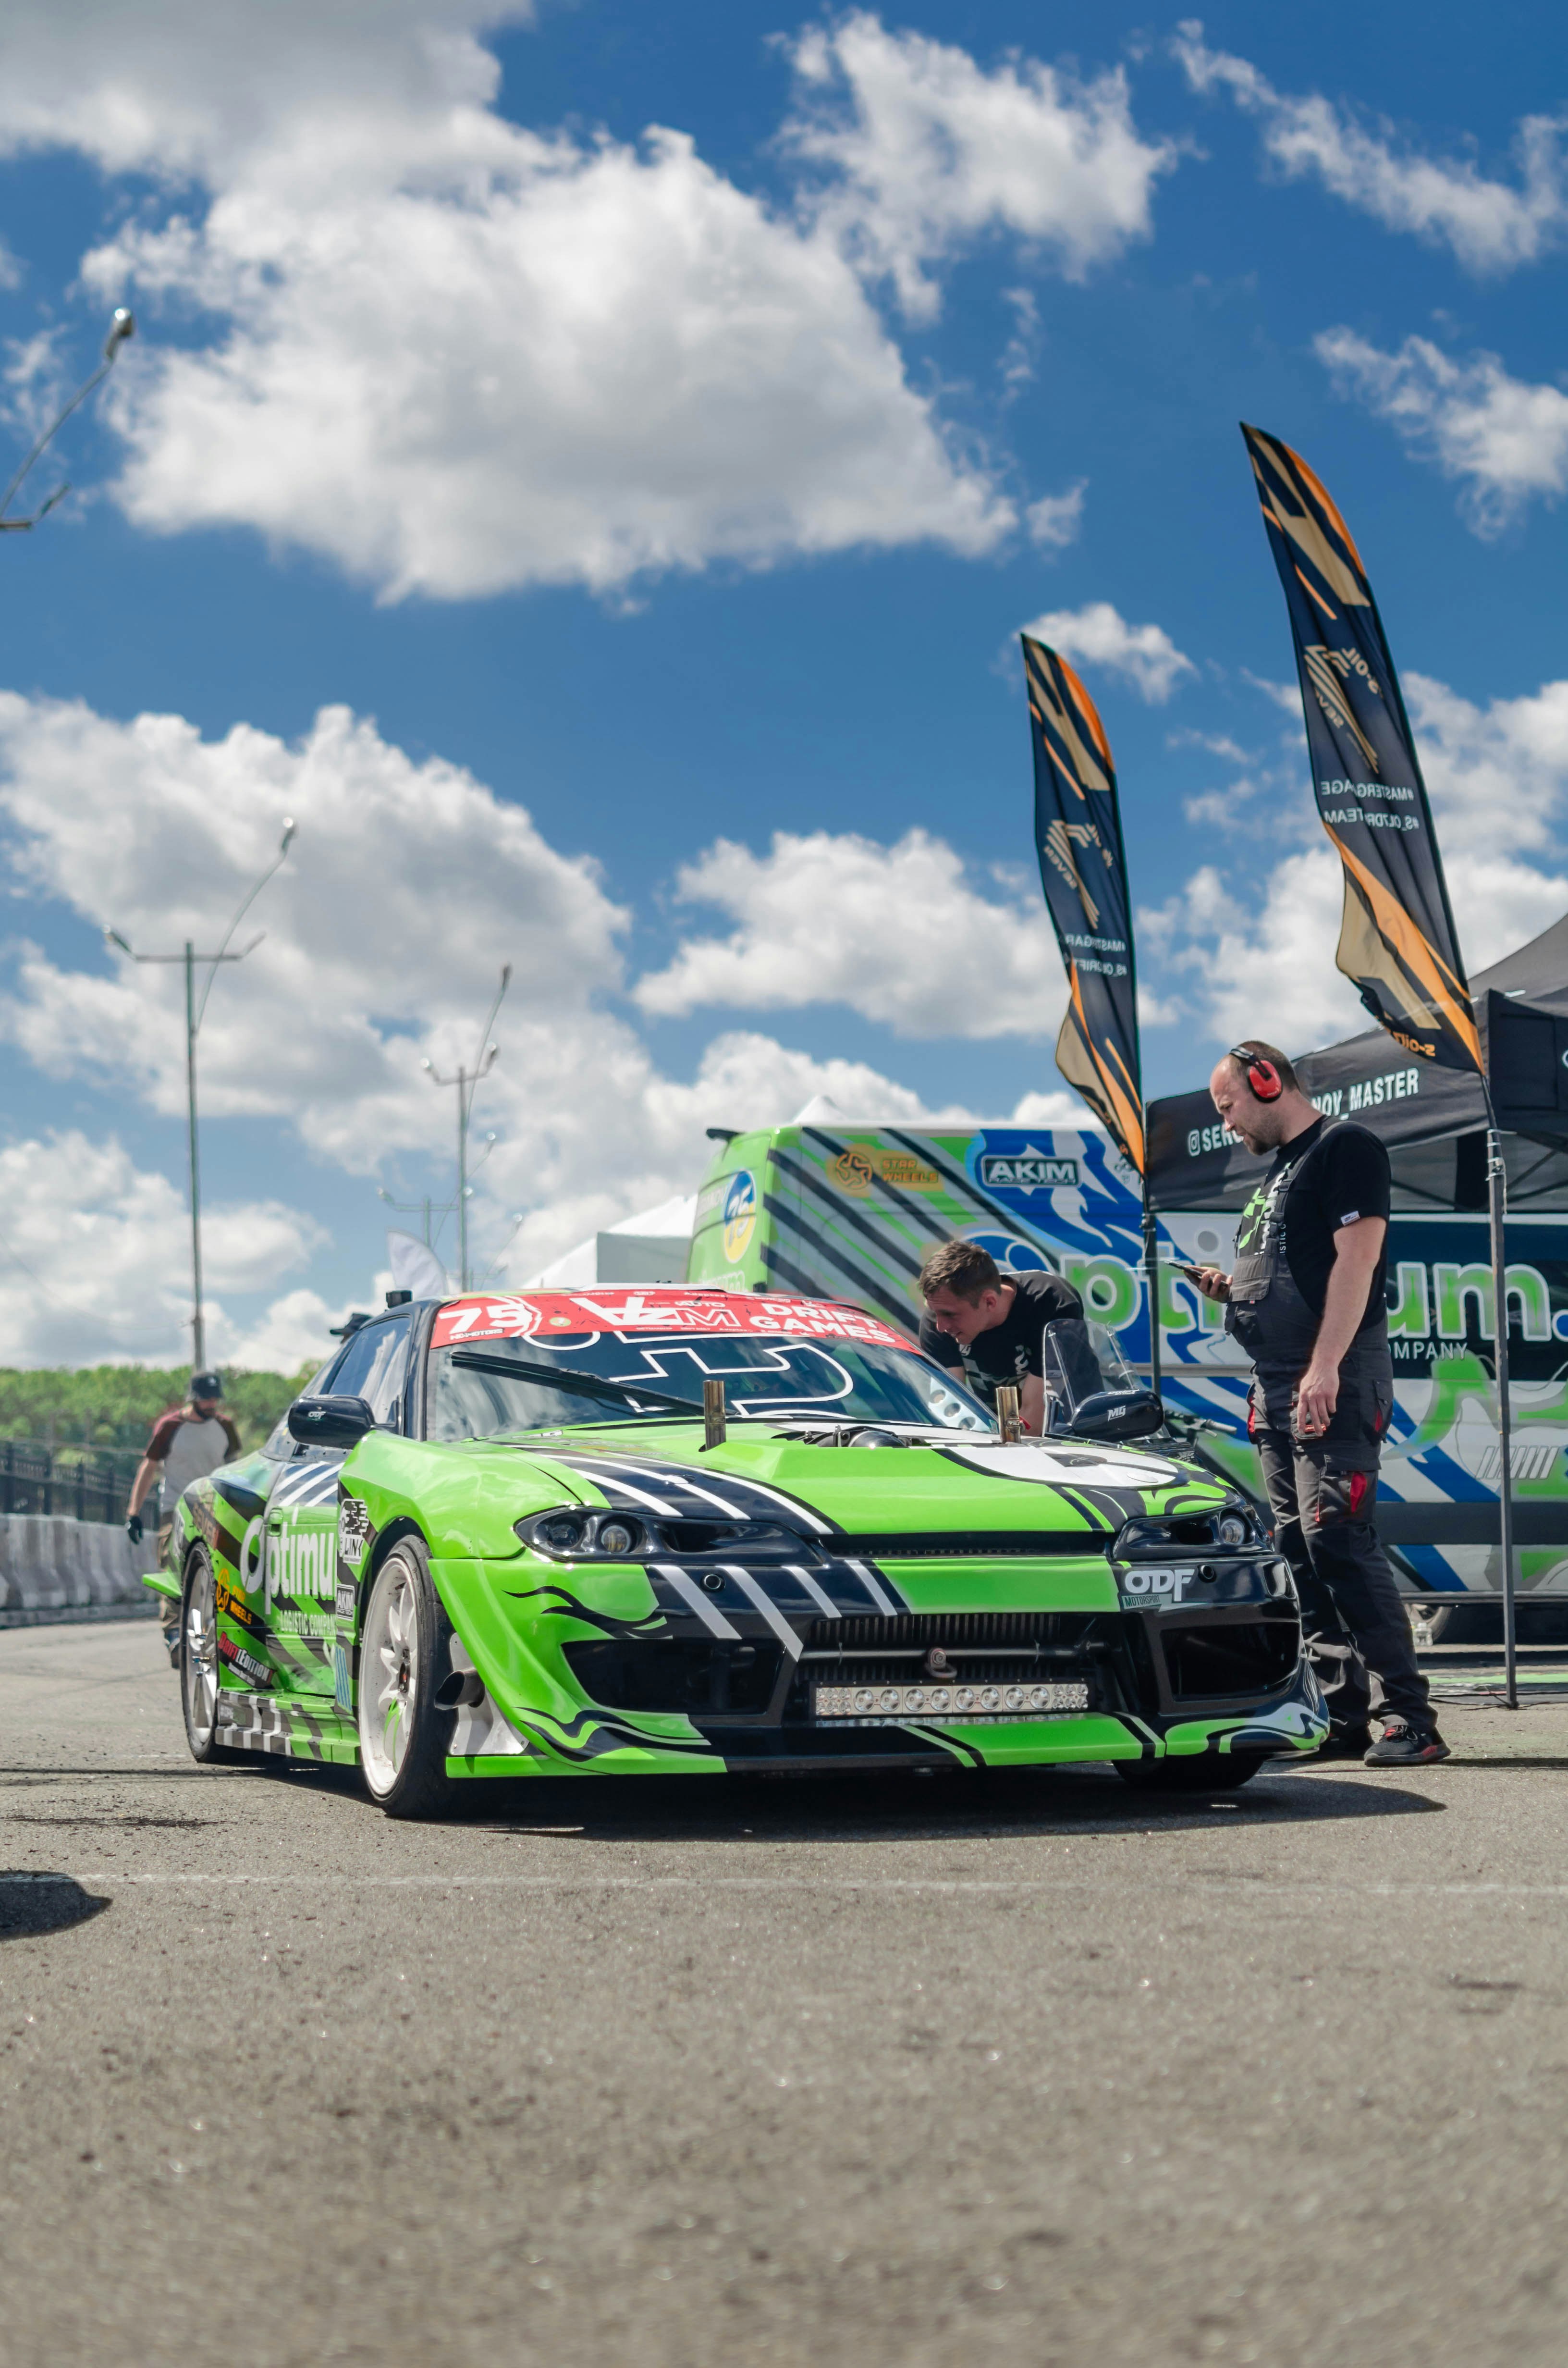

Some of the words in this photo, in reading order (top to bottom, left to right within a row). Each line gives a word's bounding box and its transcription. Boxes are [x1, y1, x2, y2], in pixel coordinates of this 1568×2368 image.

[882, 1159, 917, 1169] STAR
[990, 1161, 1076, 1180] AKIM
[882, 1172, 938, 1182] WHEELS
[438, 1304, 531, 1334] 75
[761, 1303, 878, 1329] DRIFT
[749, 1316, 896, 1343] GAMES
[1390, 1341, 1468, 1361] MPANY
[1107, 1406, 1126, 1421] MG
[344, 1538, 364, 1557] LINK
[240, 1505, 336, 1615] Optimu
[1125, 1569, 1195, 1602] ODF
[337, 1590, 354, 1611] AKIM
[1124, 1595, 1160, 1607] MOTORSPORT
[230, 1600, 252, 1625] WHEELS
